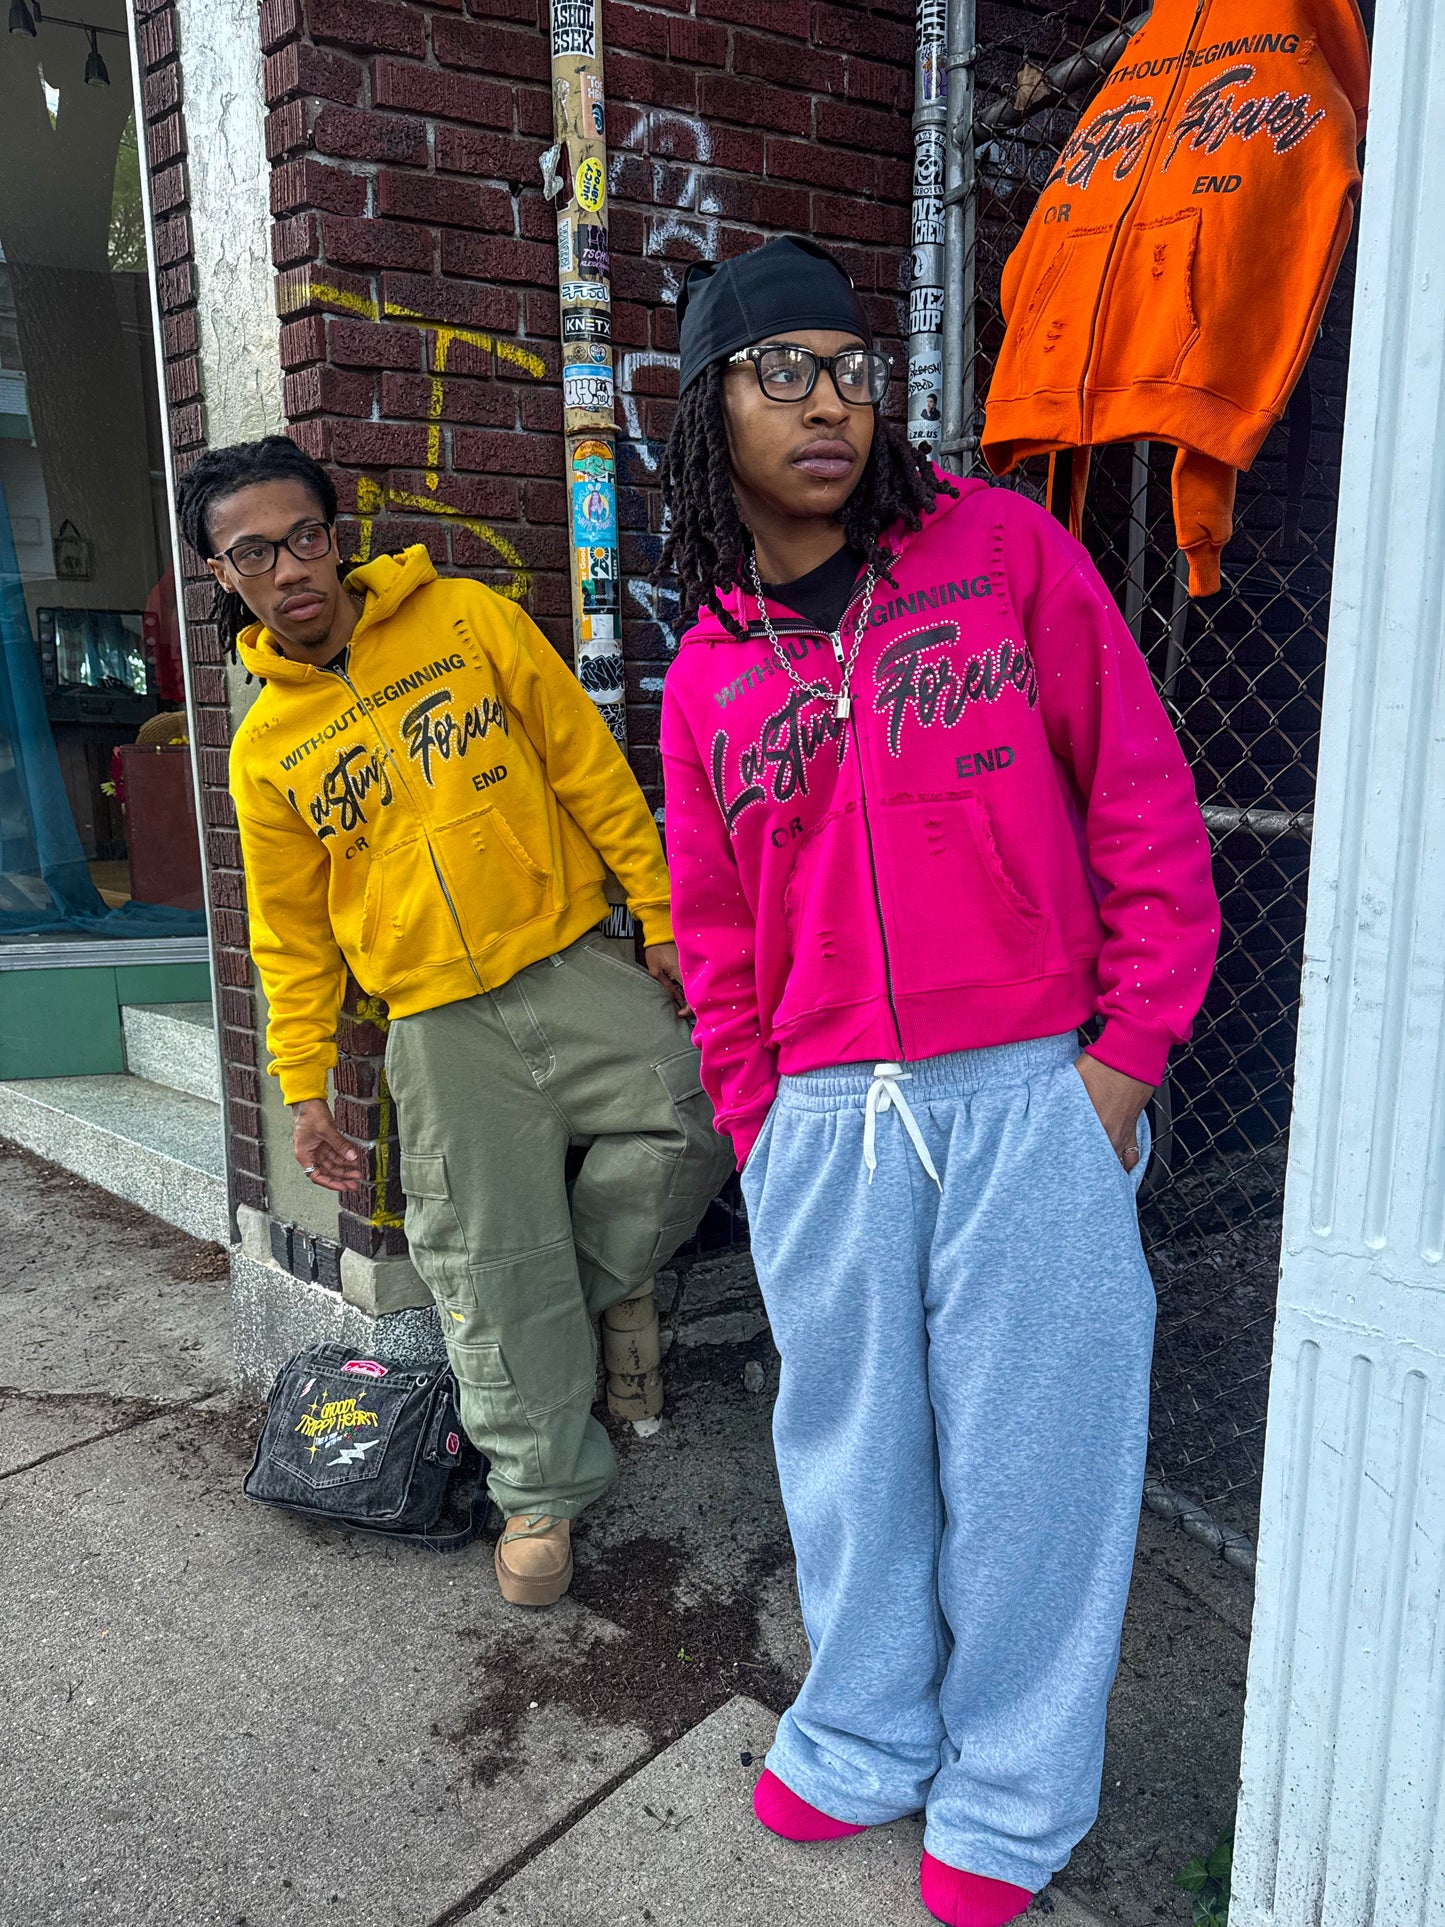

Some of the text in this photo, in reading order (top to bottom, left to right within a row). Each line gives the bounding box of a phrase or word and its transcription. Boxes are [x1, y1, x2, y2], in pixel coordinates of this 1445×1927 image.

[553, 4, 594, 31] ASHOL
[553, 29, 594, 56] ESEK
[1176, 34, 1301, 70] BEGINNING
[1161, 63, 1326, 175] Forever
[1043, 174, 1242, 225] OR END
[279, 653, 466, 772] WITHOUT BEGINNING
[872, 619, 1040, 759] Forever
[345, 764, 508, 860] OR END
[771, 745, 1016, 848] OR END
[295, 1409, 379, 1438] TRIPPY HEART
